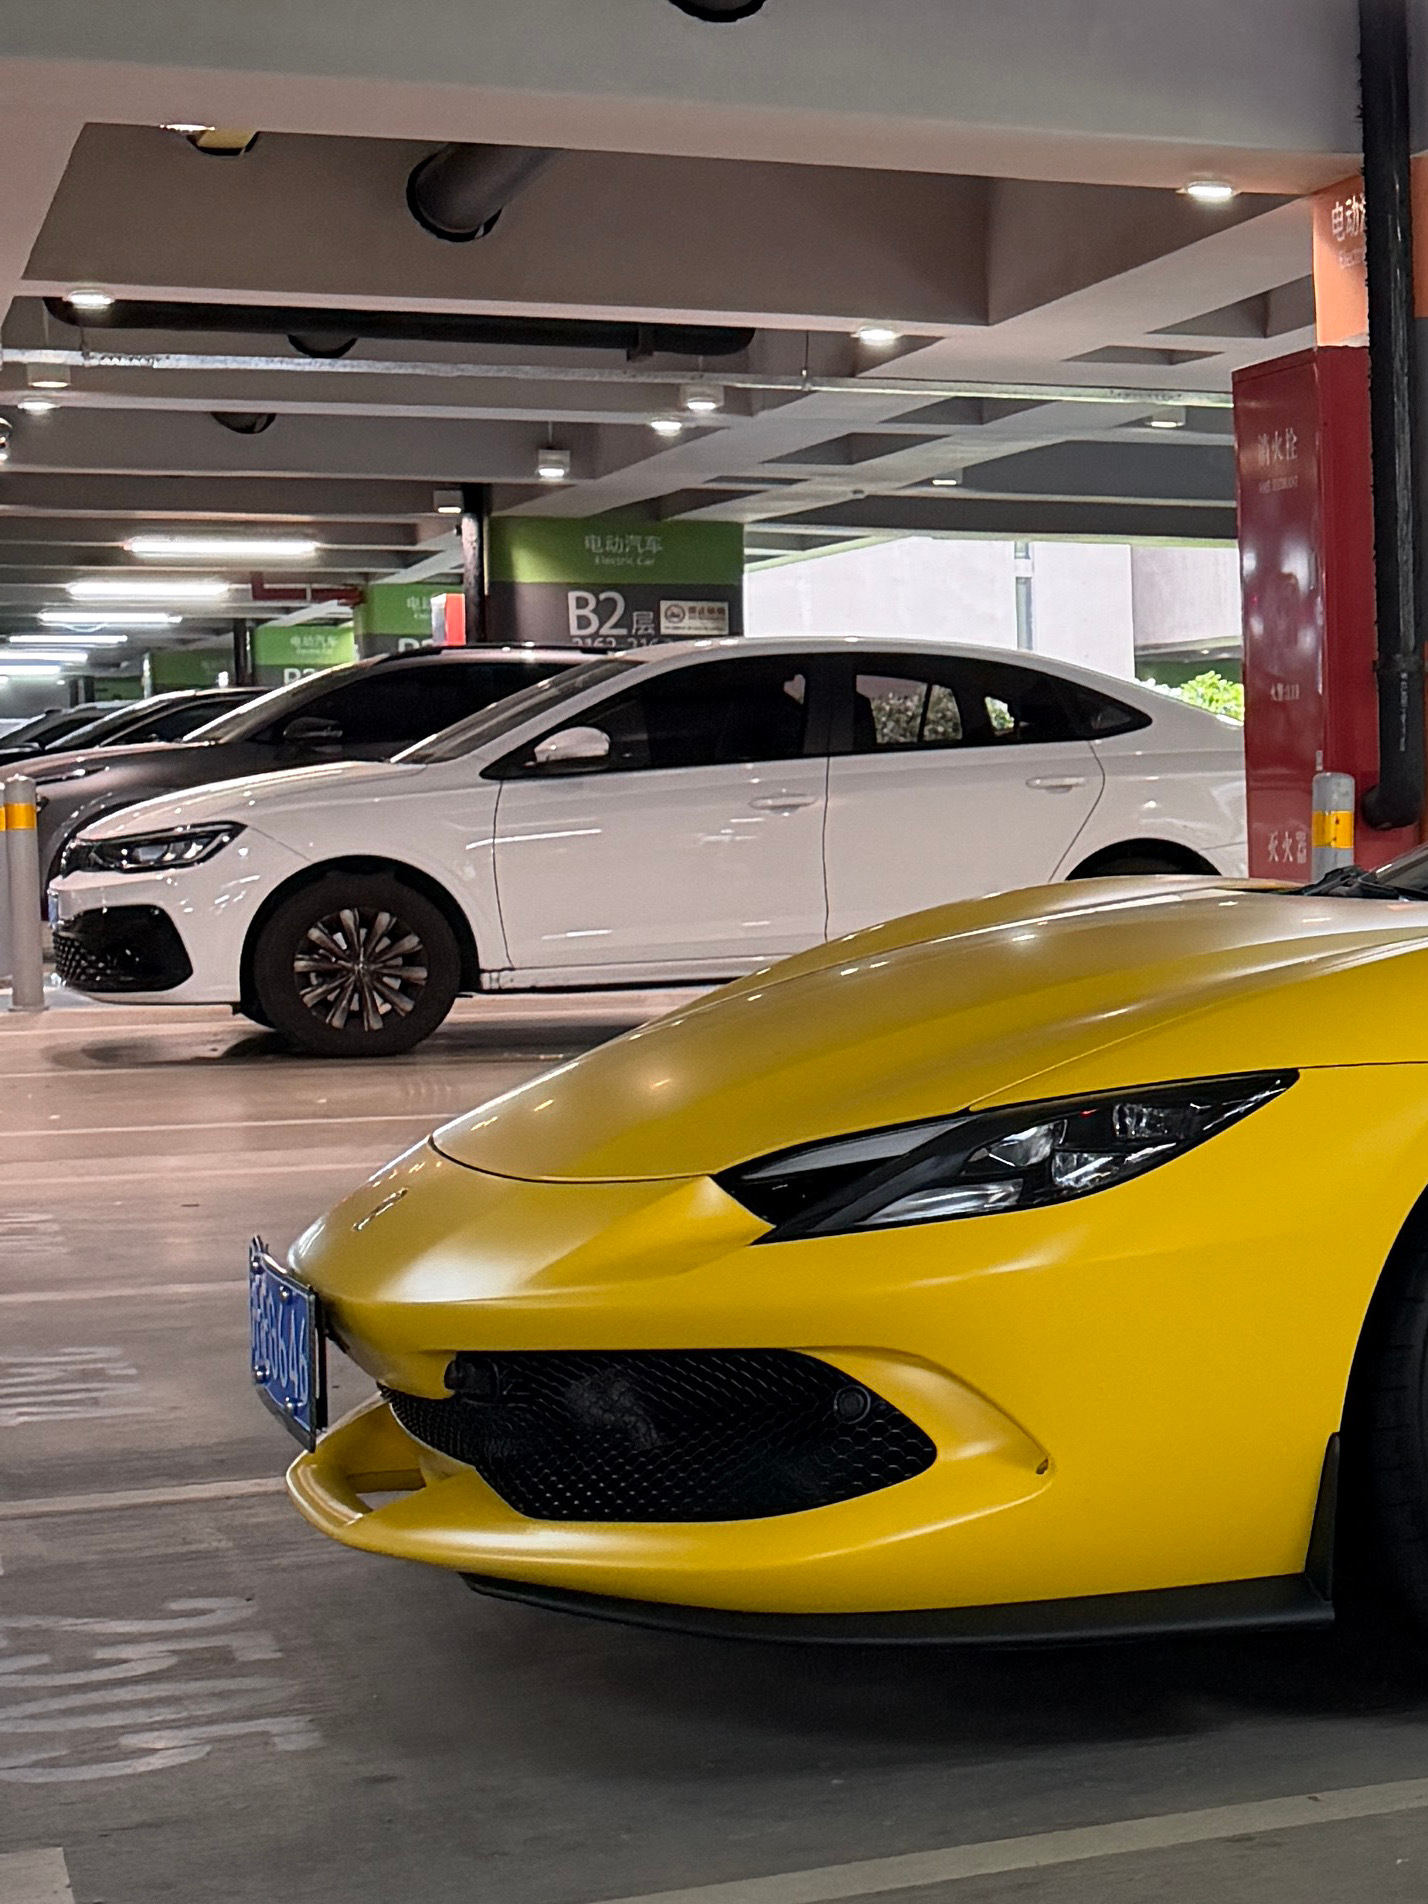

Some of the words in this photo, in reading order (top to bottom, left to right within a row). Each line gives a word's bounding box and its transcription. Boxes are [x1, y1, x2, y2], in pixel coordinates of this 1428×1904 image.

[585, 535, 662, 554] 电动汽车
[595, 557, 634, 566] Electric
[637, 557, 656, 566] Car
[0, 1596, 326, 1784] 2505
